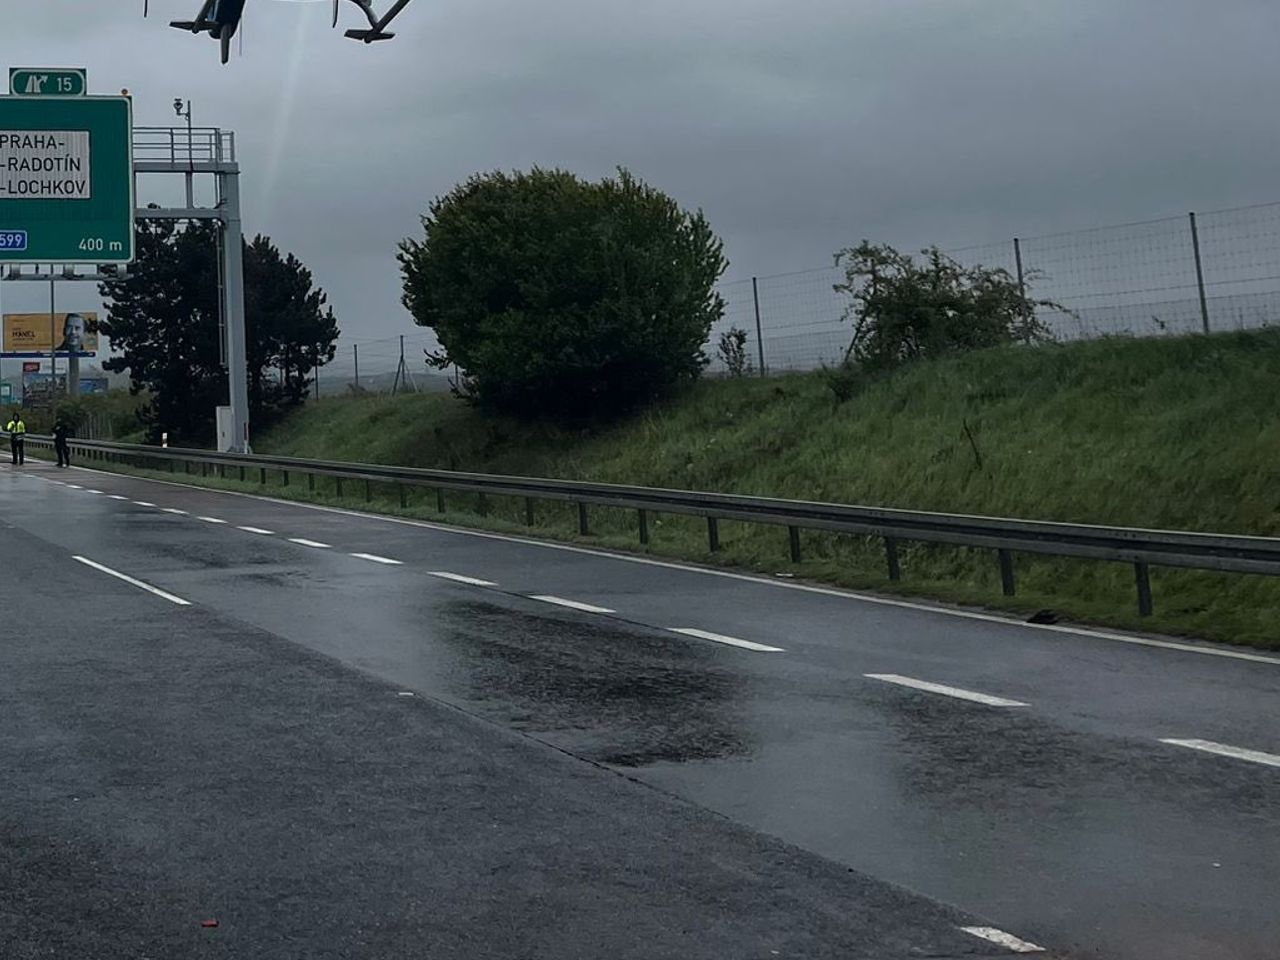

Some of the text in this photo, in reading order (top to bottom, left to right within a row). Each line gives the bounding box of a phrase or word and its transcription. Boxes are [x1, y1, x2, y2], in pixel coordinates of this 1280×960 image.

[57, 77, 73, 92] 15
[0, 153, 81, 172] -RADOTÍN
[0, 180, 85, 195] -LOCHKOV
[78, 238, 122, 251] 400 m
